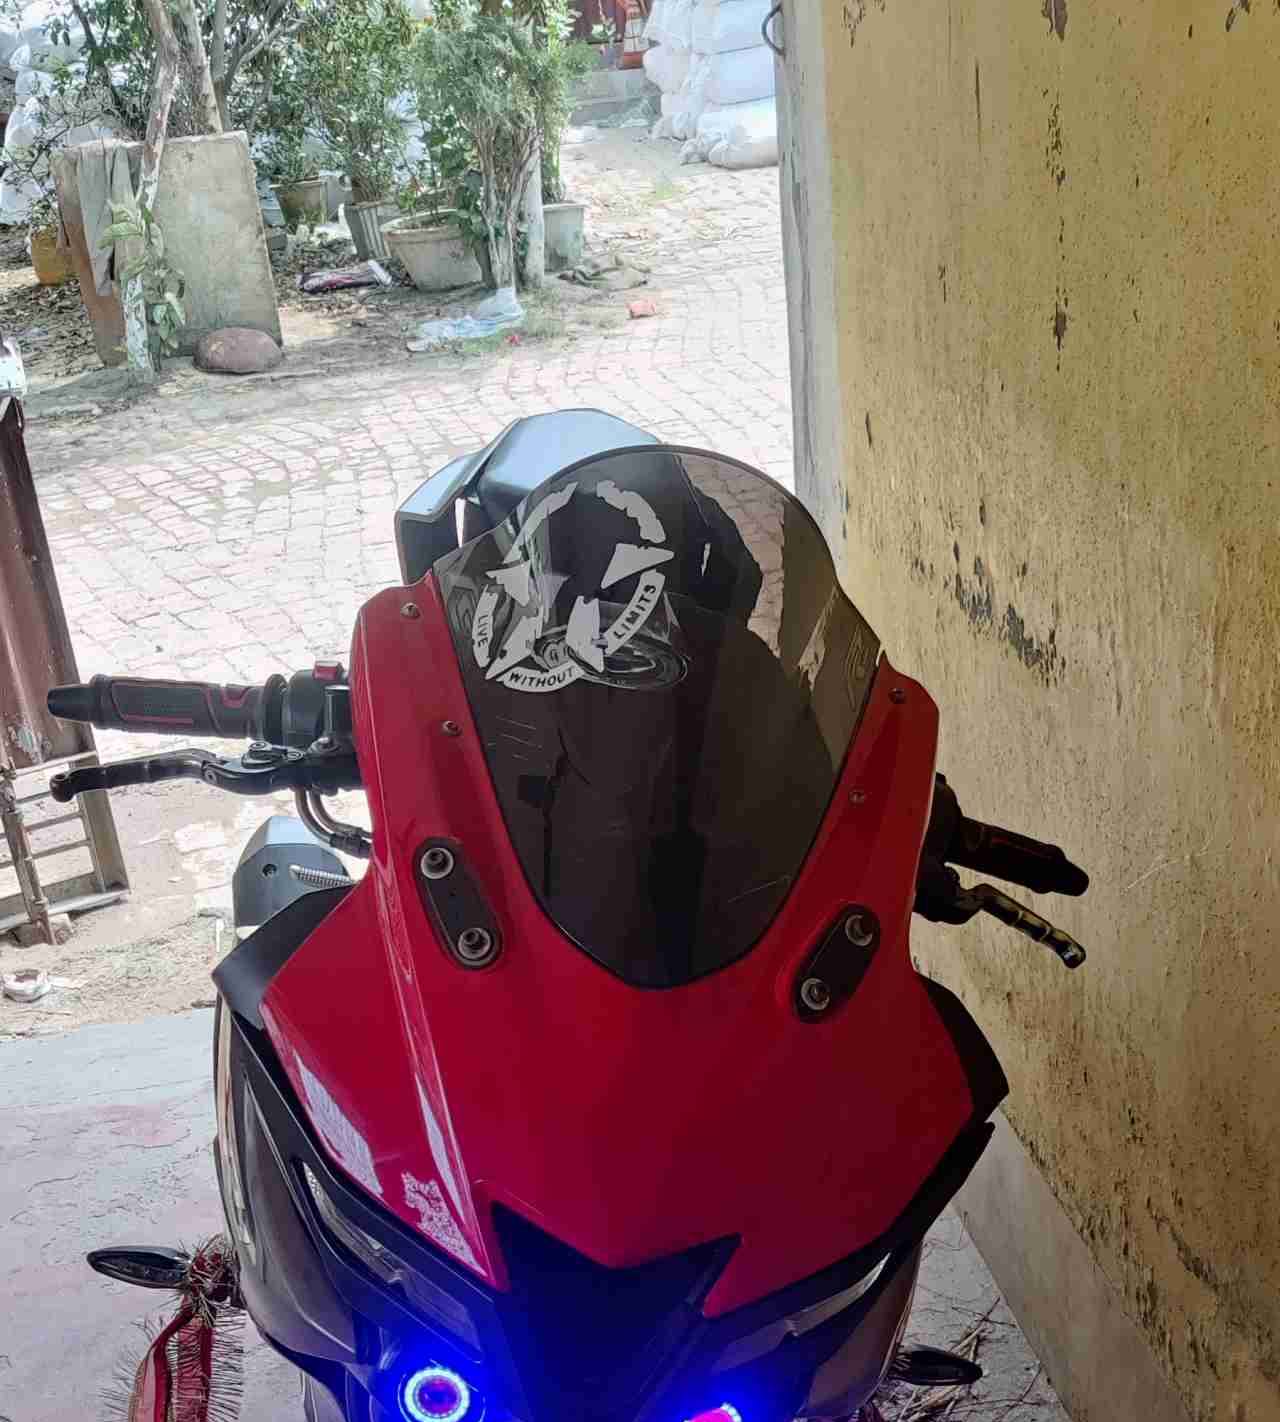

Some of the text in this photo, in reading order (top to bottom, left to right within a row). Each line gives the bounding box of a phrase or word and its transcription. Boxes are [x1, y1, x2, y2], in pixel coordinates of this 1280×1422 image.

[478, 584, 657, 688] LIVE WITHOUT LIMITS
